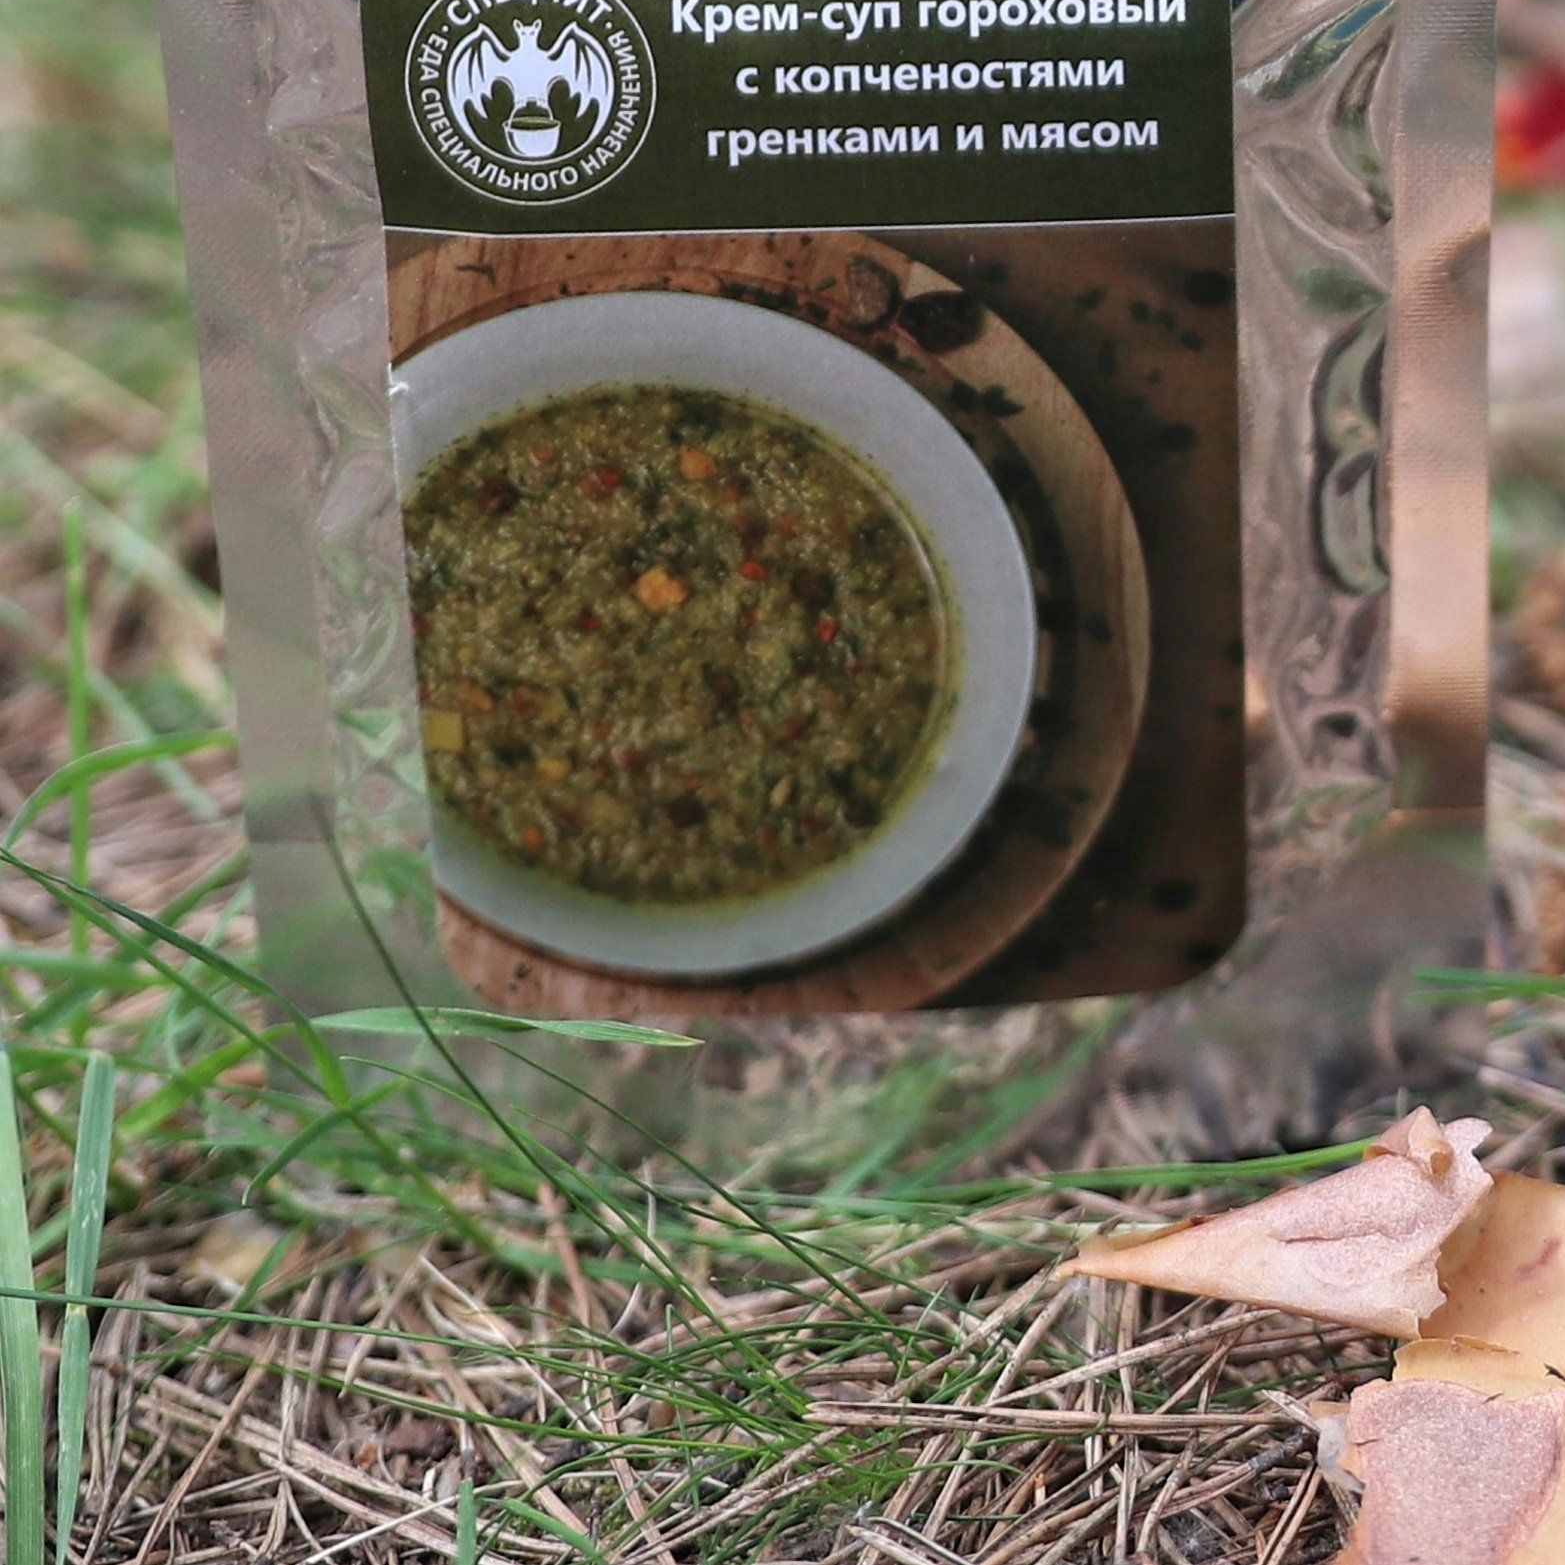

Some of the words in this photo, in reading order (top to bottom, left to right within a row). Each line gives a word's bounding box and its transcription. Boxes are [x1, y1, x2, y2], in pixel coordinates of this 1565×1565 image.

[418, 33, 448, 81] ЕДА
[735, 67, 759, 94] с
[775, 59, 1125, 94] копченостями
[580, 30, 641, 176] НАЗНАЧЕНИЯ
[421, 88, 578, 191] СПЕЦИАЛЬНОГО
[707, 124, 939, 167] гренками
[957, 124, 984, 151] и
[1002, 120, 1159, 150] мясом
